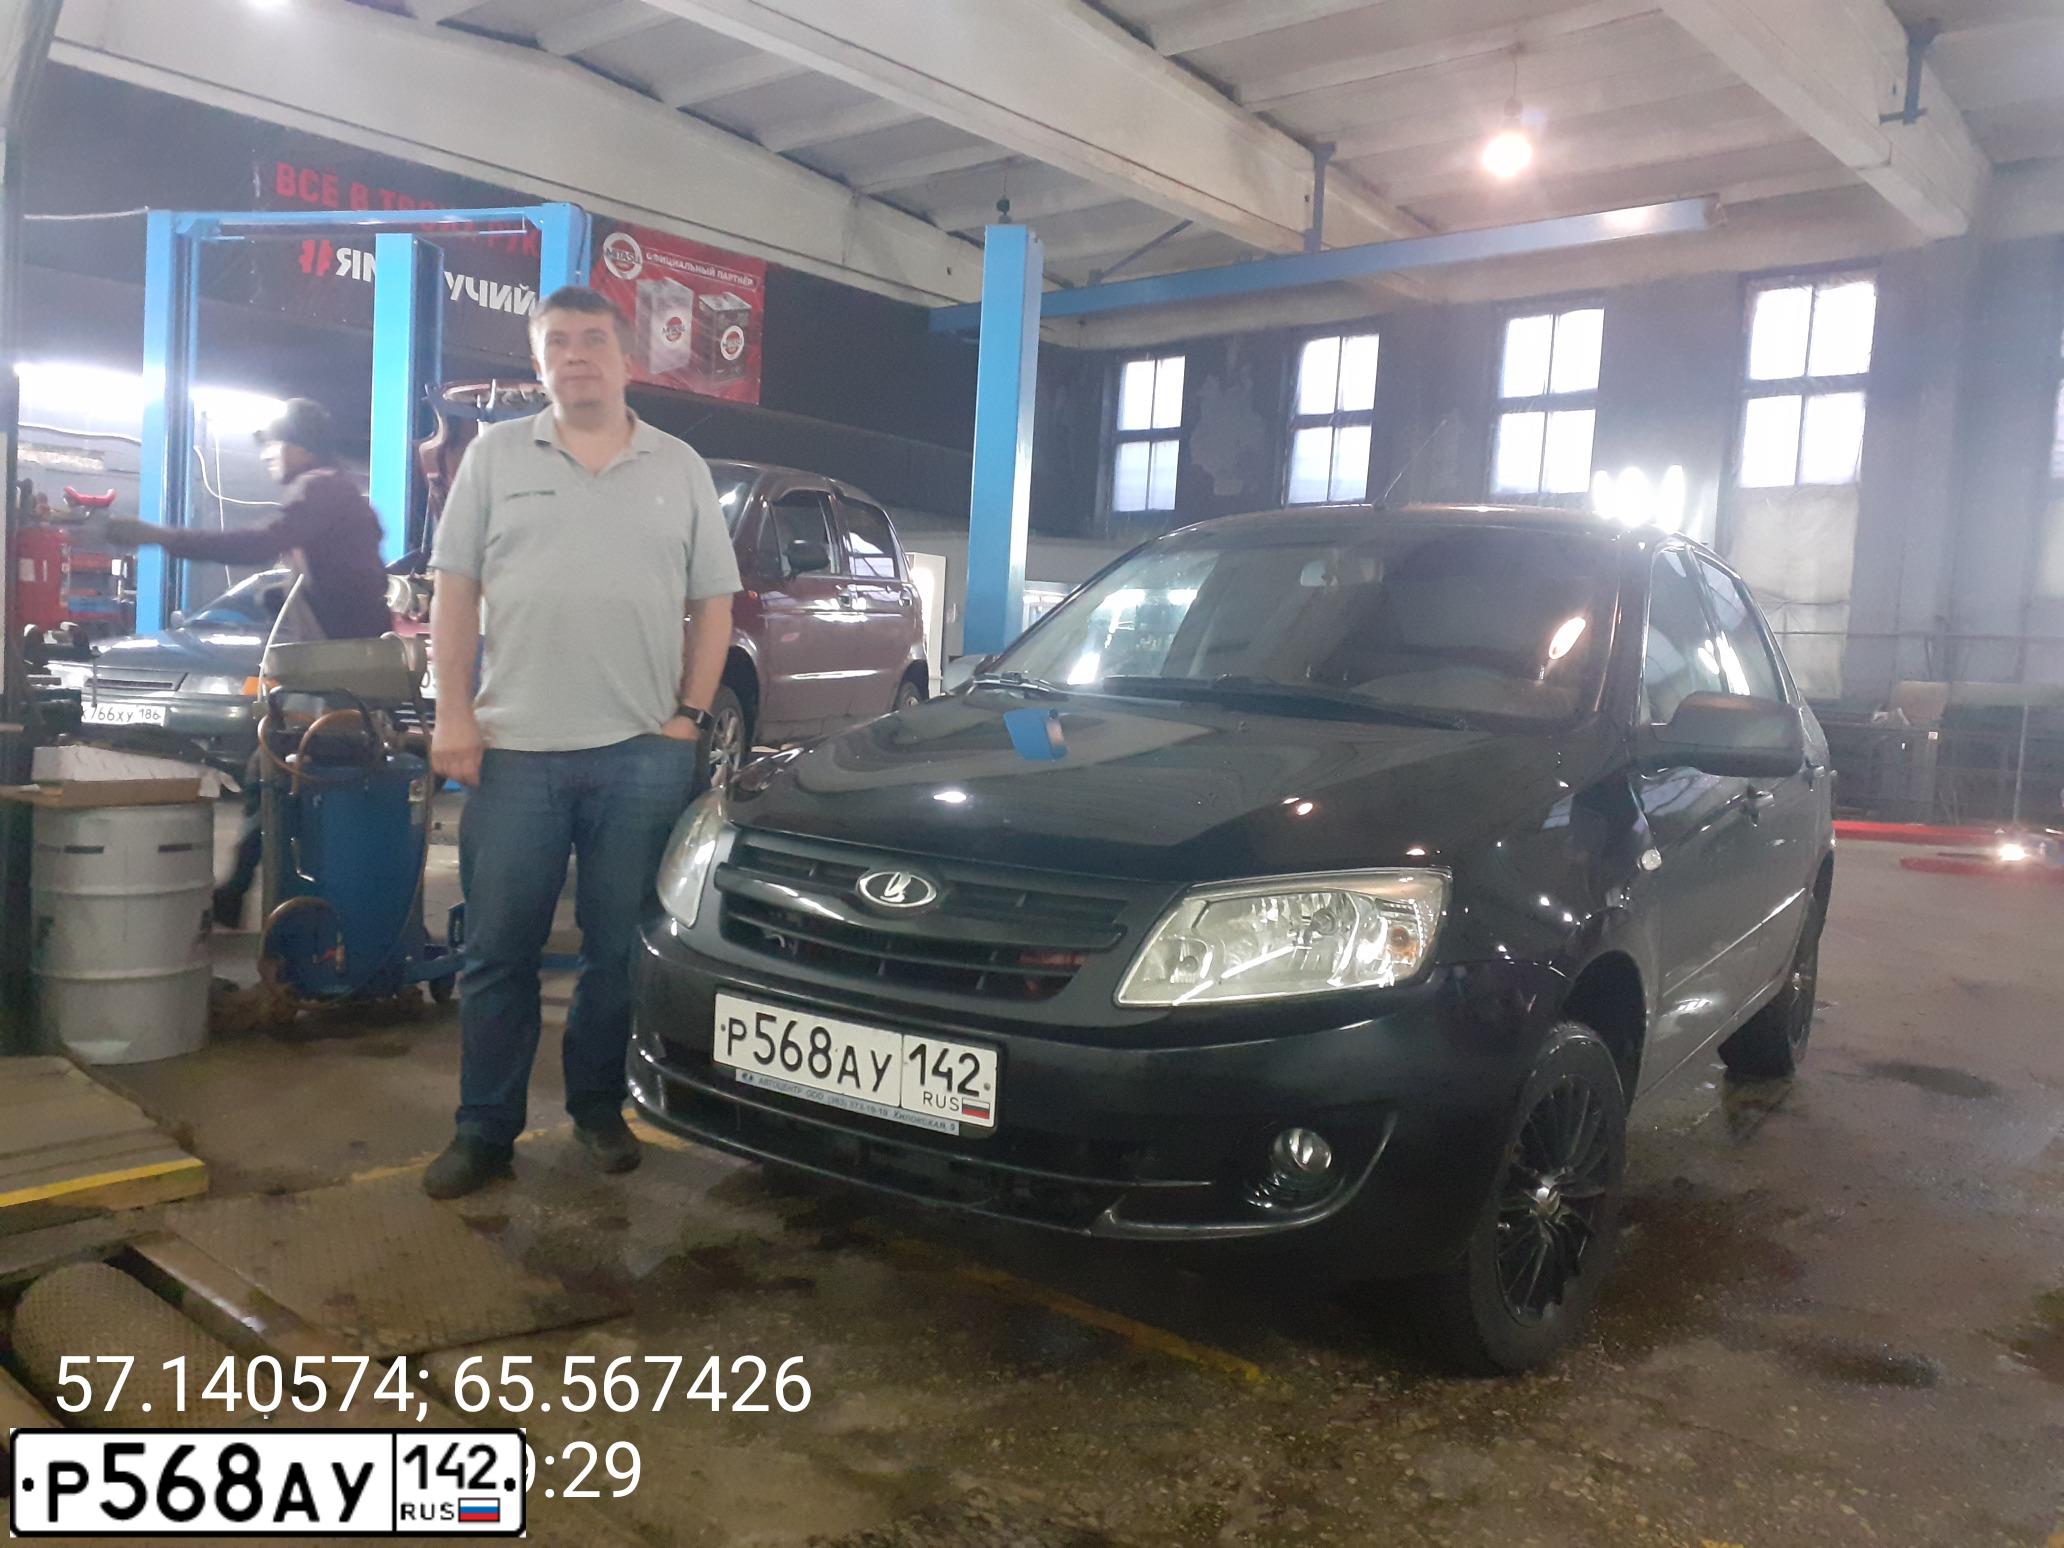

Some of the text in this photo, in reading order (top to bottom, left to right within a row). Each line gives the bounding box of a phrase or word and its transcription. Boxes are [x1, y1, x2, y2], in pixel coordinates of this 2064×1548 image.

[276, 161, 338, 208] ВСЁ
[727, 1012, 980, 1097] Р568АУ 142
[922, 1090, 960, 1112] RUS
